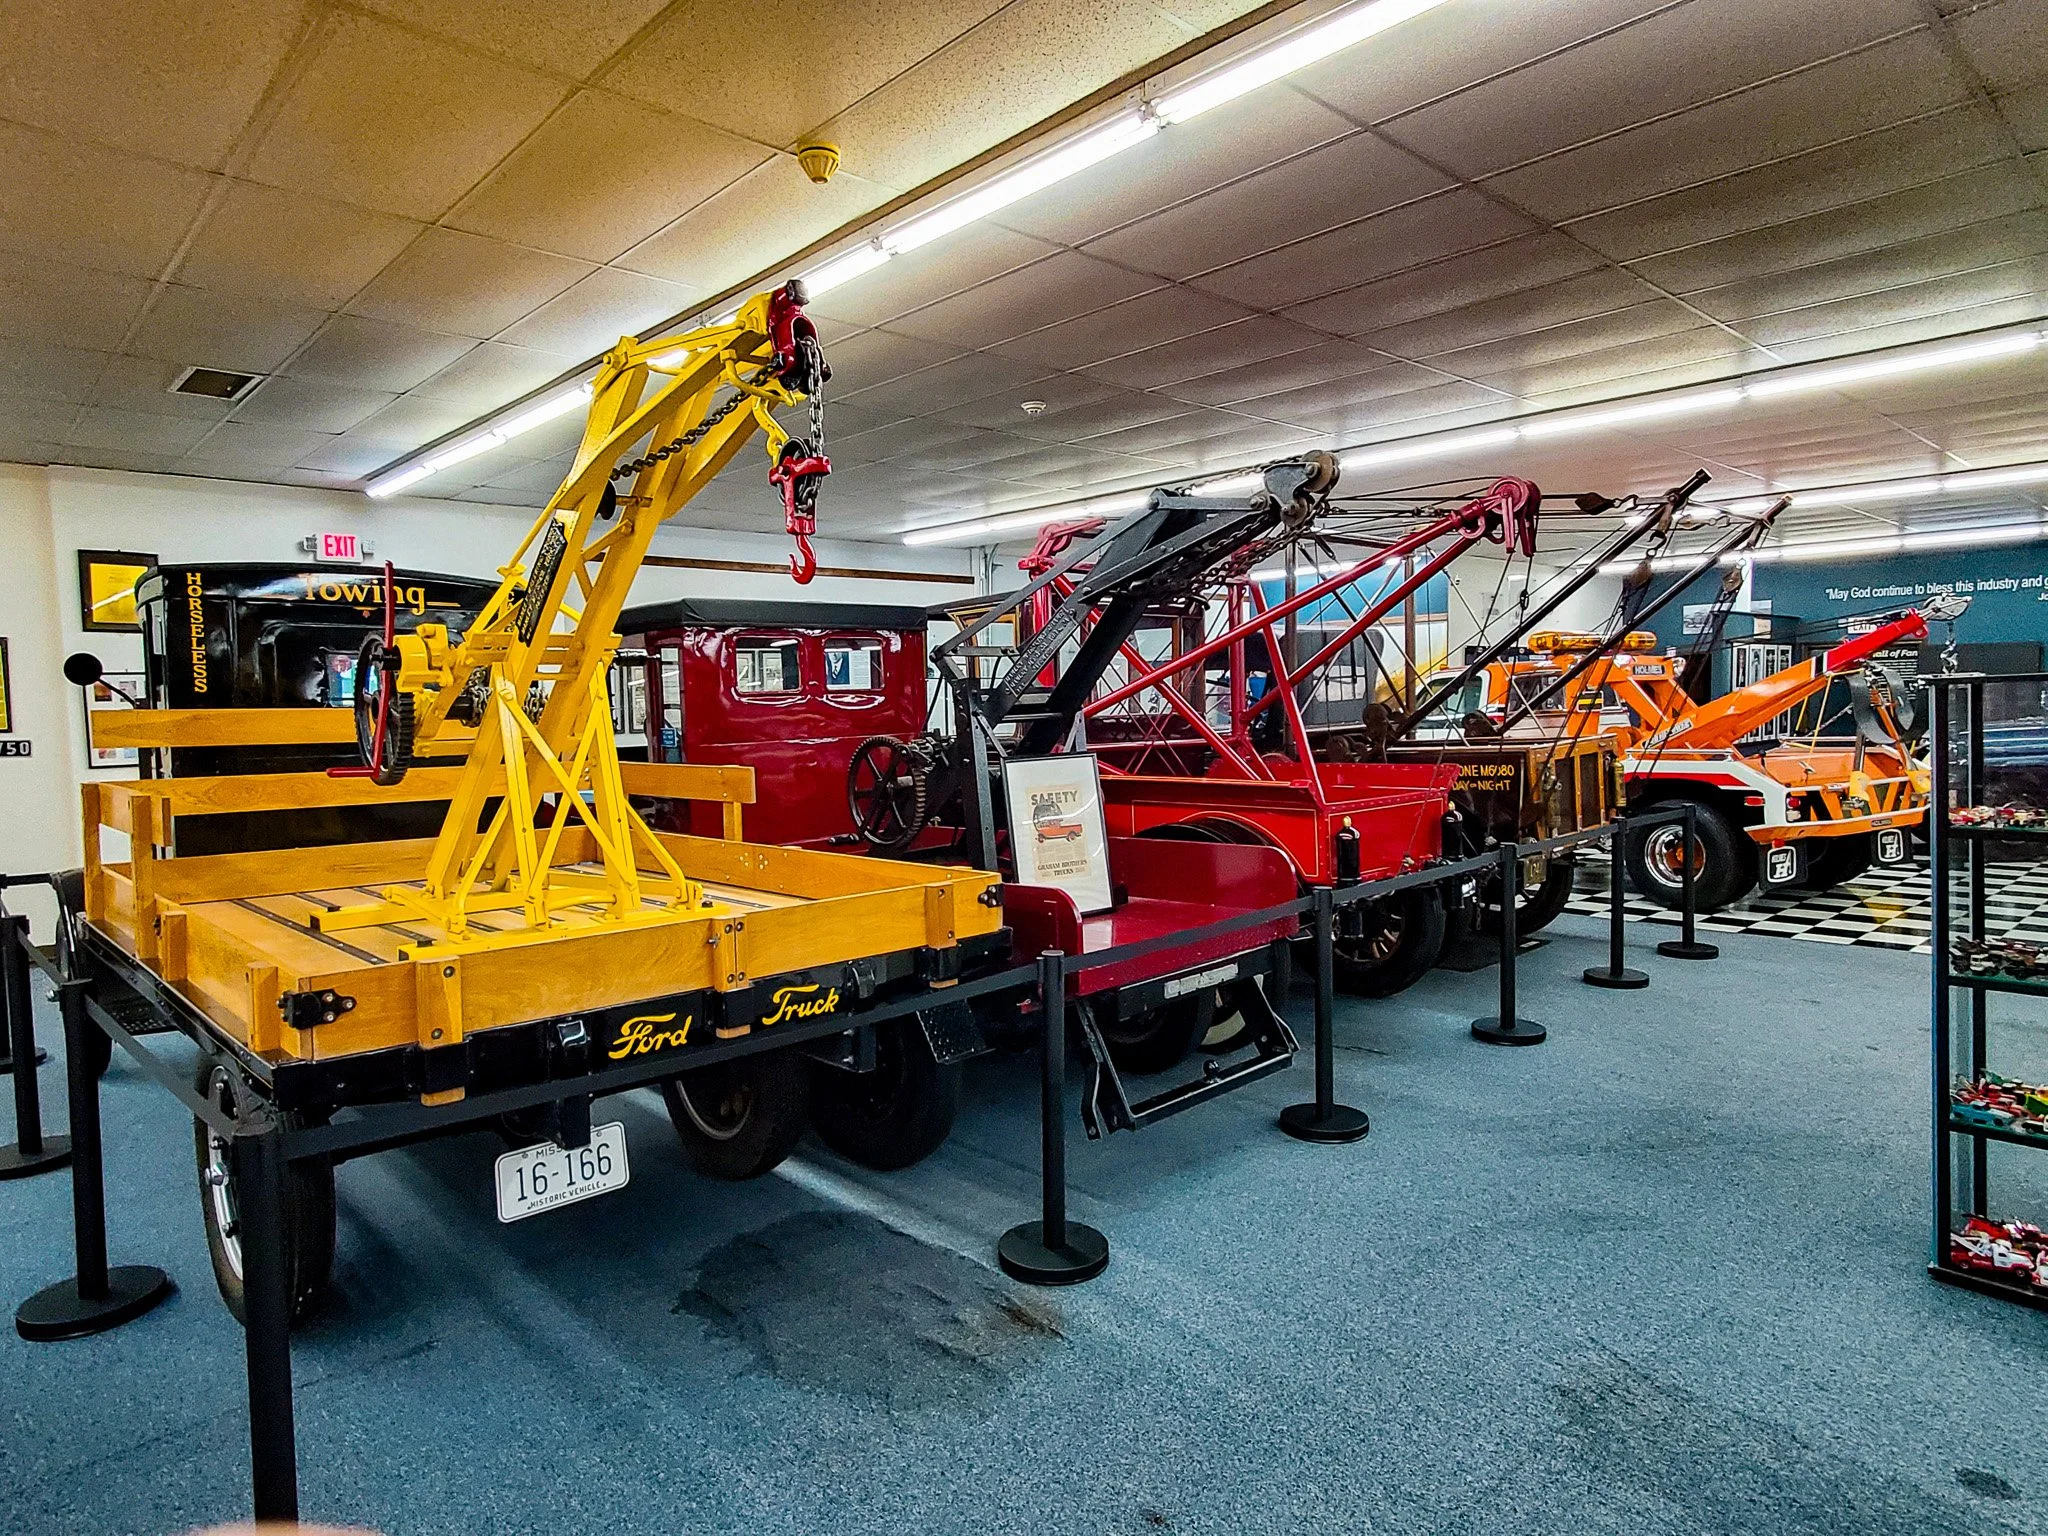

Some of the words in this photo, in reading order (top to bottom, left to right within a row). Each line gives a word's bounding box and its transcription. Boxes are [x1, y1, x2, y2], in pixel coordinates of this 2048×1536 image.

[324, 534, 356, 558] EXIT
[1826, 588, 1849, 601] "May
[1850, 587, 1870, 598] God
[1872, 585, 1913, 597] continue
[1915, 584, 1924, 595] to
[1927, 583, 1953, 594] bless
[1955, 580, 1974, 592] this
[1977, 578, 2019, 592] industry
[2021, 575, 2043, 588] and
[186, 572, 208, 693] HORSELESS
[1890, 650, 1901, 658] of
[1634, 665, 1663, 675] HOLMES
[1031, 790, 1077, 805] SAFETY
[1053, 868, 1074, 876] TRUCKS
[608, 1012, 693, 1060] Ford
[761, 984, 839, 1026] Truck
[516, 1143, 612, 1202] 16-166
[529, 1191, 567, 1209] HISTORIC
[569, 1181, 601, 1197] VEHICLE
